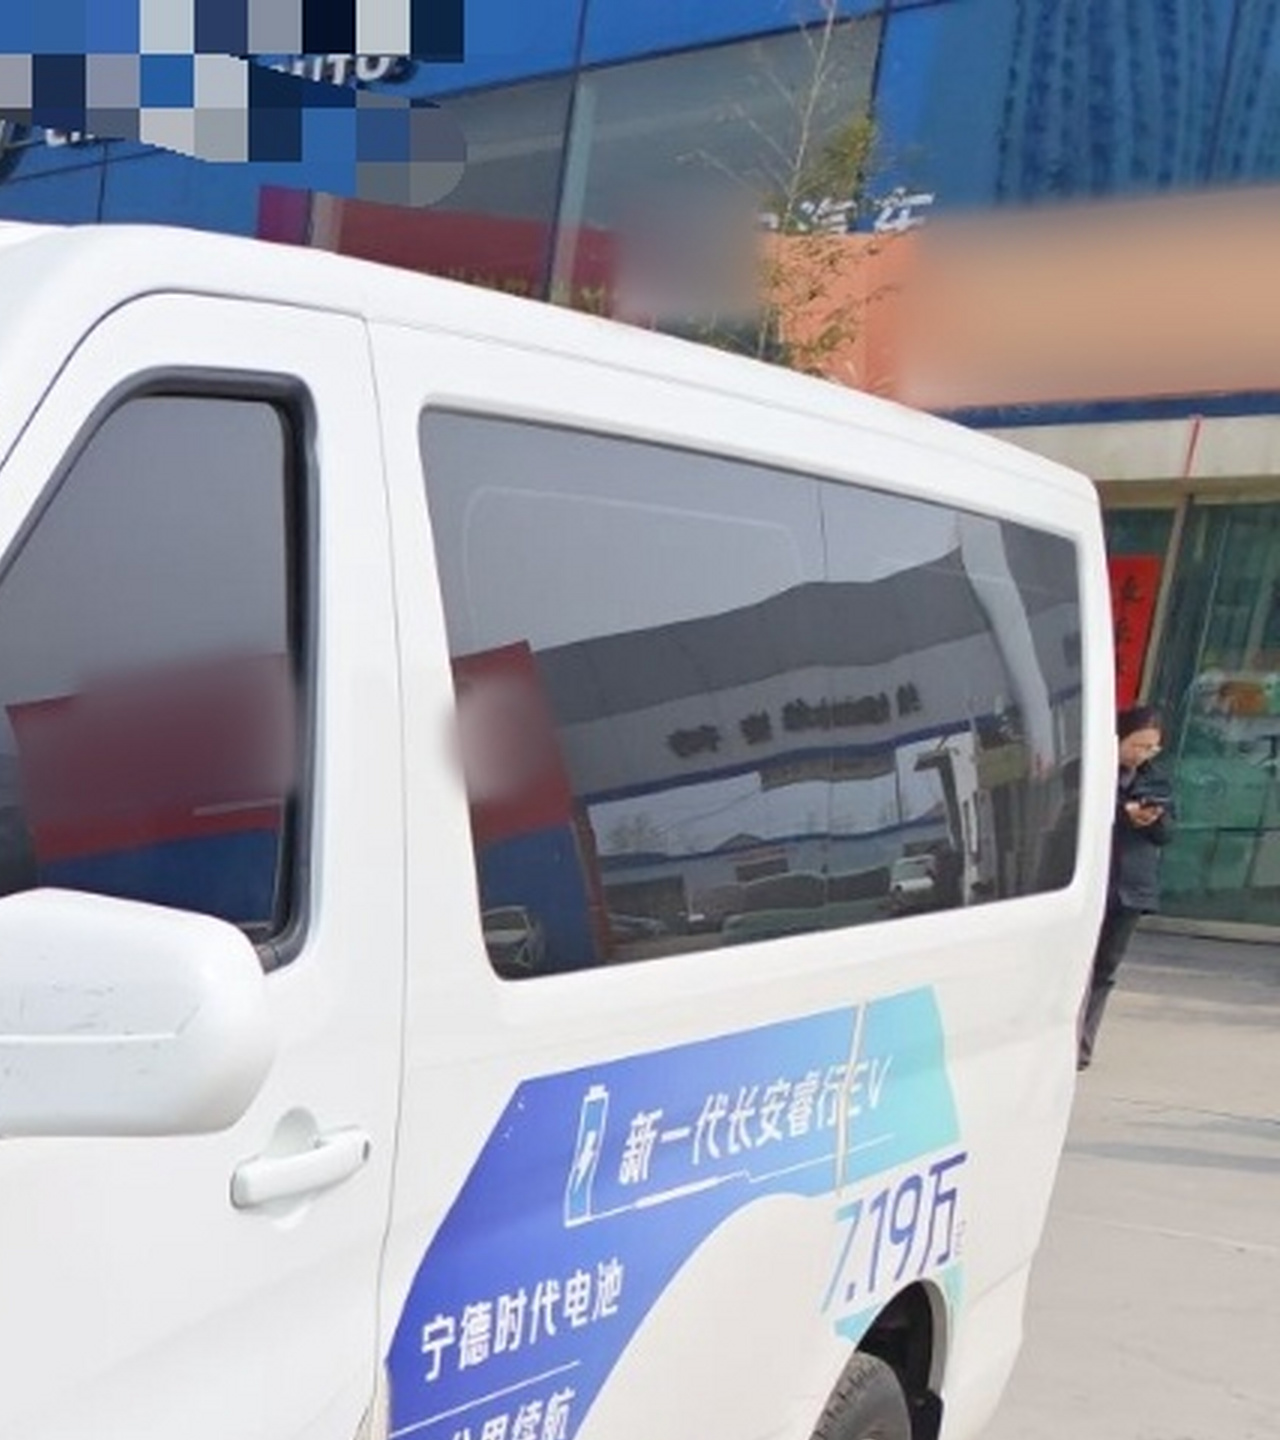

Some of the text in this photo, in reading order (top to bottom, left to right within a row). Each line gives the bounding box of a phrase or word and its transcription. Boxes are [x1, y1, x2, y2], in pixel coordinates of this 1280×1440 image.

[421, 1257, 624, 1381] 宁德时代电池
